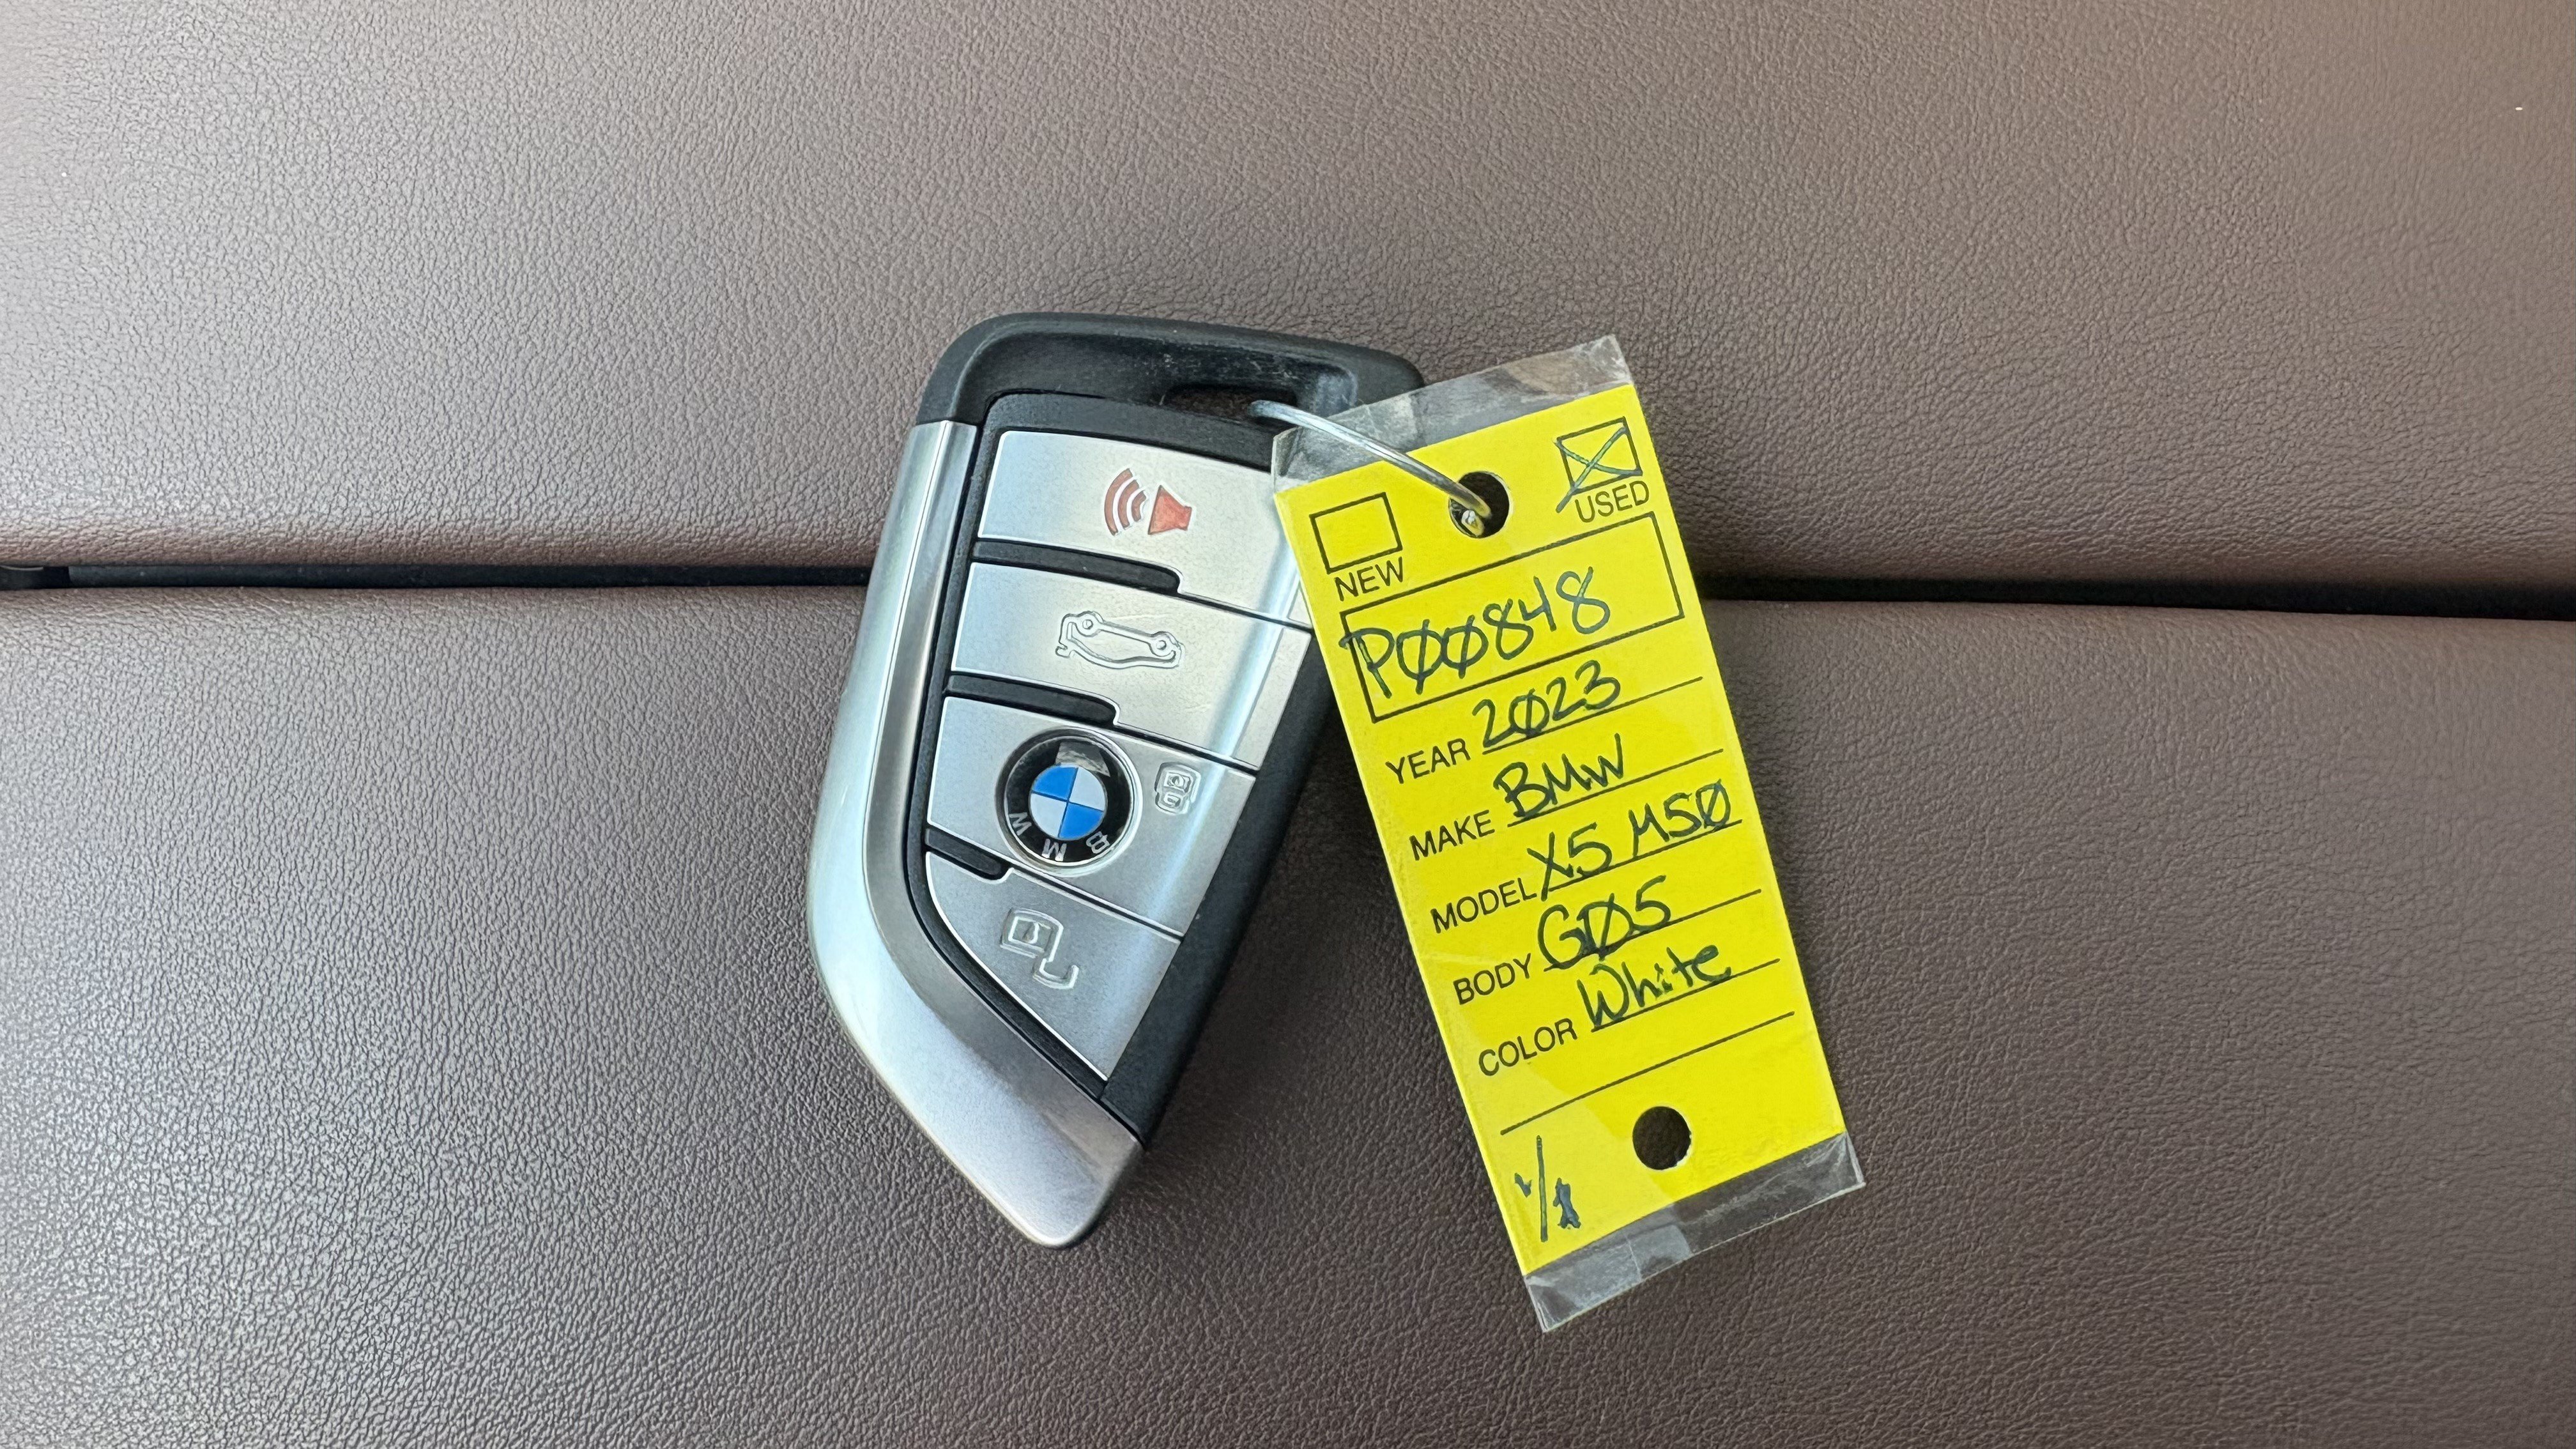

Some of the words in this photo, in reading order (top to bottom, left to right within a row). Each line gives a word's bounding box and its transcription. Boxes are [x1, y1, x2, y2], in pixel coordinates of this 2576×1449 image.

[1574, 480, 1650, 523] USED
[1334, 558, 1404, 601] NEW
[1338, 567, 1611, 698] P00848
[1386, 739, 1471, 785] YEAR
[1472, 659, 1621, 748] 2023
[1008, 811, 1110, 862] BMW
[1409, 811, 1496, 861] MAKE
[1430, 878, 1537, 933] MODEL
[1527, 823, 1612, 901] X5
[1629, 779, 1731, 859] M50
[1453, 953, 1531, 1005] BODY
[1478, 1018, 1577, 1077] COLOR
[1576, 944, 1731, 1030] White
